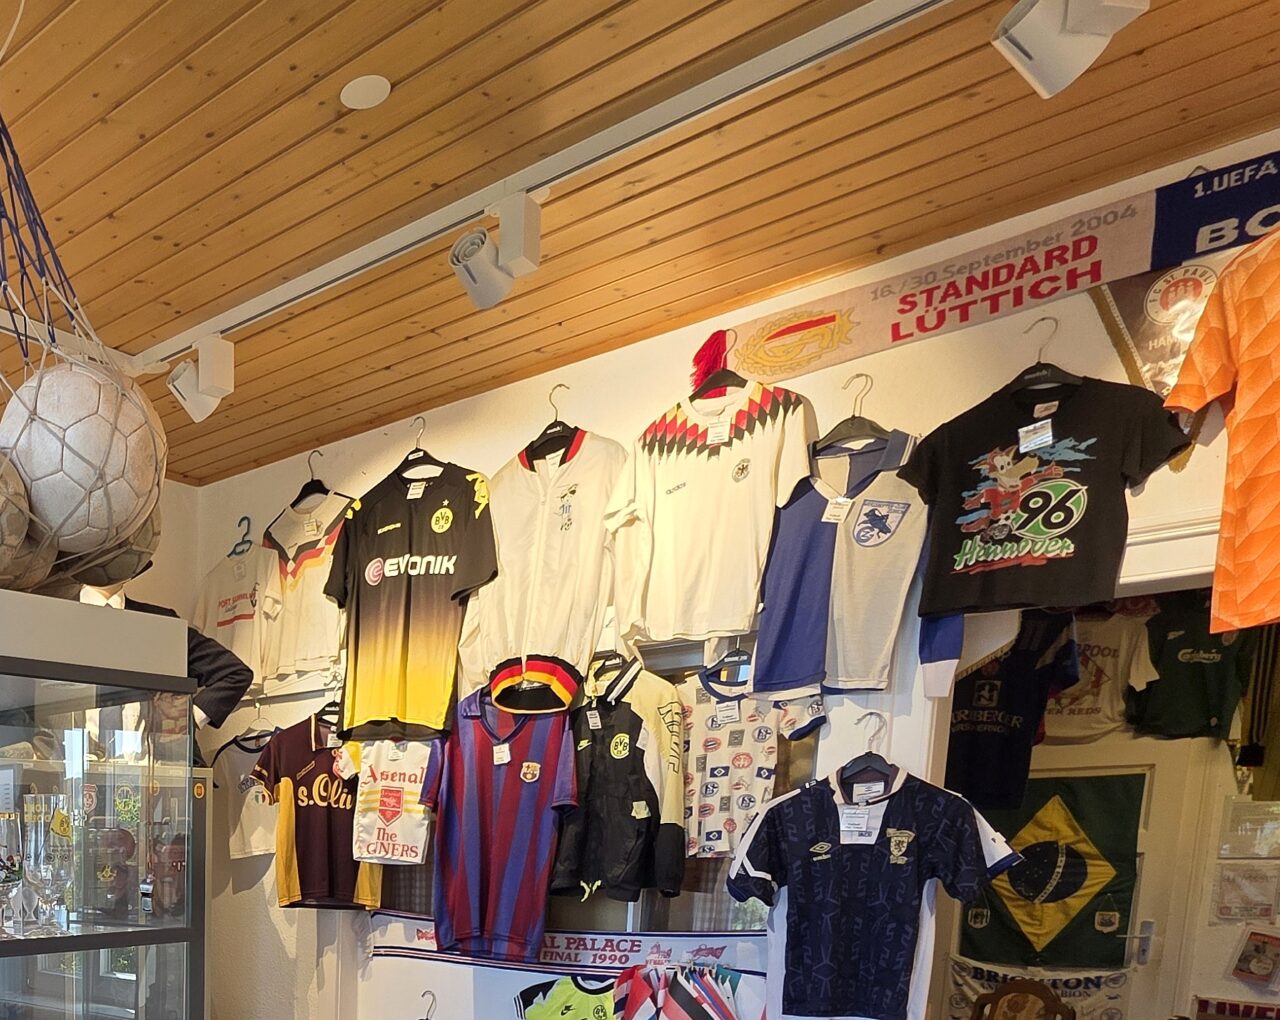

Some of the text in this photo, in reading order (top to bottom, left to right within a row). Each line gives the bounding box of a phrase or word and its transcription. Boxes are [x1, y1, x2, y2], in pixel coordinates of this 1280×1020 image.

[941, 230, 1063, 279] September
[1071, 204, 1138, 237] 2004
[897, 234, 1099, 315] STANDARD
[890, 259, 1103, 343] LÜTTICH
[1013, 486, 1087, 534] 96
[384, 554, 457, 577] EVONIK
[376, 828, 398, 843] The
[564, 936, 642, 953] PALACE
[542, 950, 630, 965] FINAL 1990
[971, 966, 1103, 990] BRITON
[1060, 990, 1092, 998] BION
